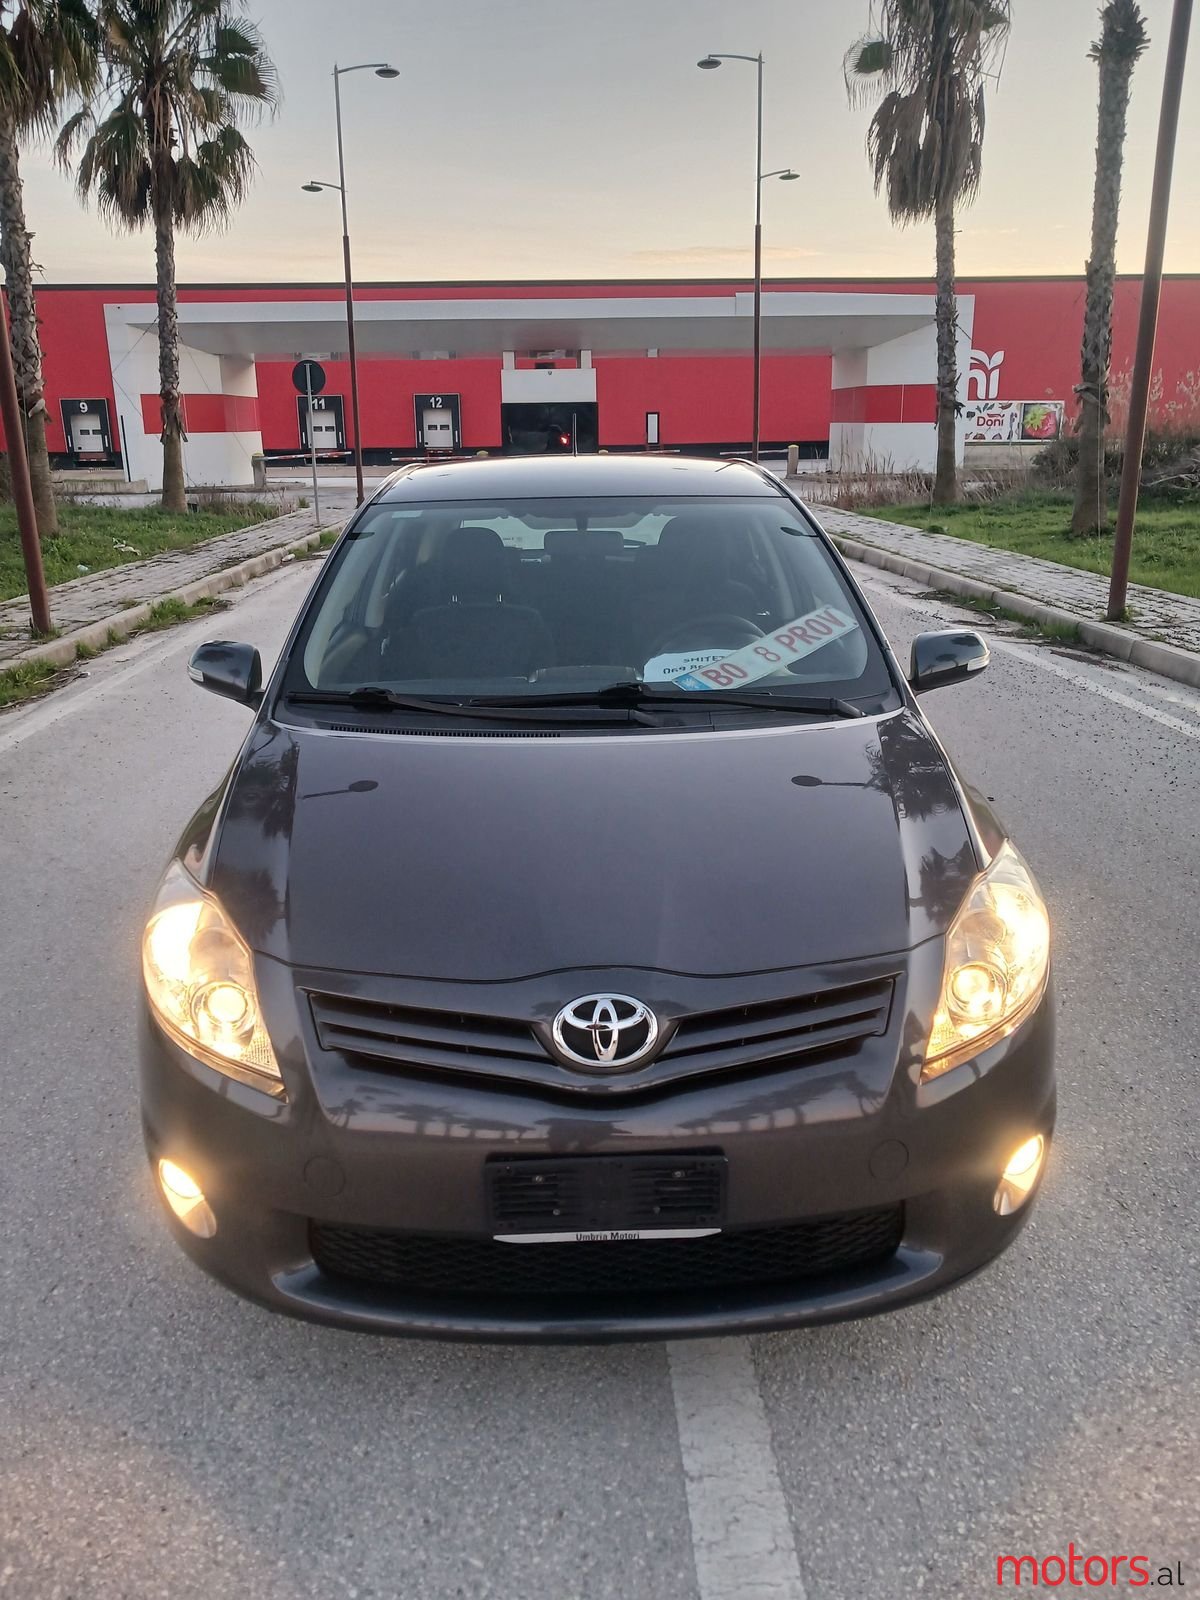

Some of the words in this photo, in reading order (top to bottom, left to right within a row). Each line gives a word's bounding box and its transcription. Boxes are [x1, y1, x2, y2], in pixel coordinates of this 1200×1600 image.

[79, 402, 88, 413] 9
[312, 398, 326, 410] 11
[429, 397, 443, 409] 12
[753, 646, 781, 663] 8
[774, 609, 847, 653] PROV
[575, 1232, 608, 1241] Umbria
[610, 1231, 640, 1240] Motori
